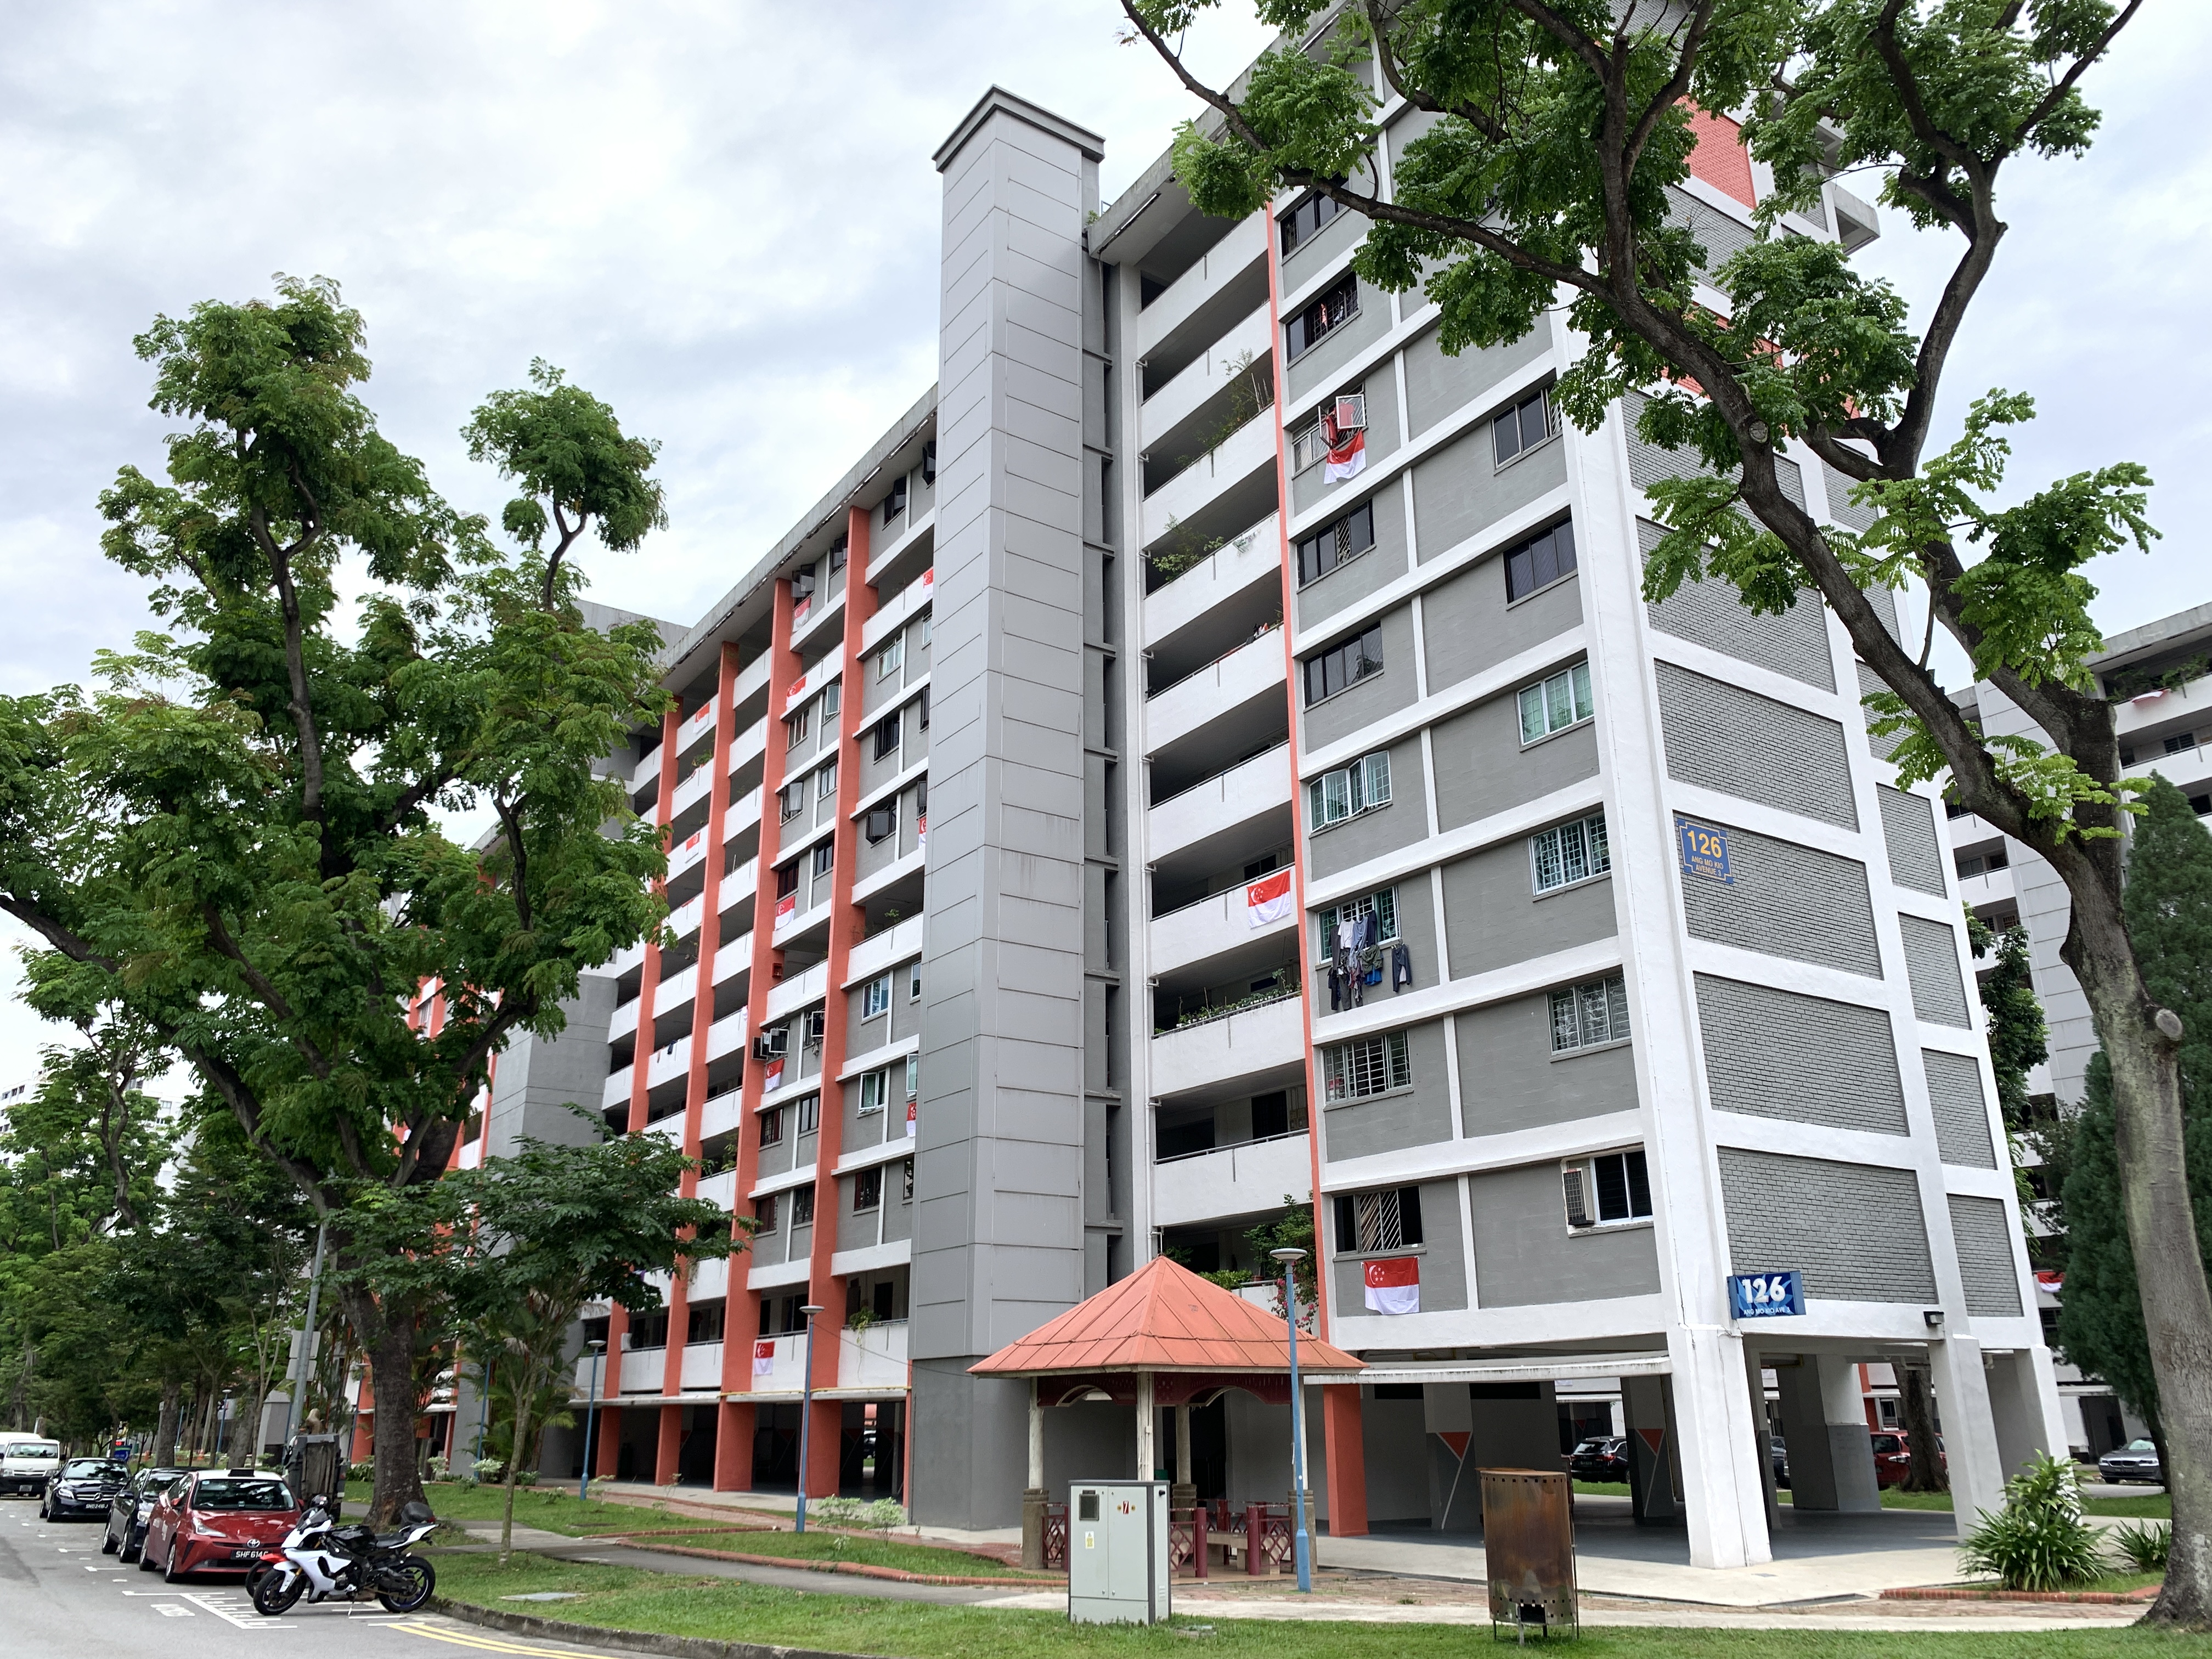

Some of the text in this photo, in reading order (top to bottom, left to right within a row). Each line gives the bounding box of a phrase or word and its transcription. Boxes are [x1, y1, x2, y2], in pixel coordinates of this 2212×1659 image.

[1687, 830, 1722, 859] 126
[1691, 855, 1724, 869] ANG MO KIO
[1696, 864, 1717, 876] AVENUE
[1741, 1276, 1786, 1304] 126
